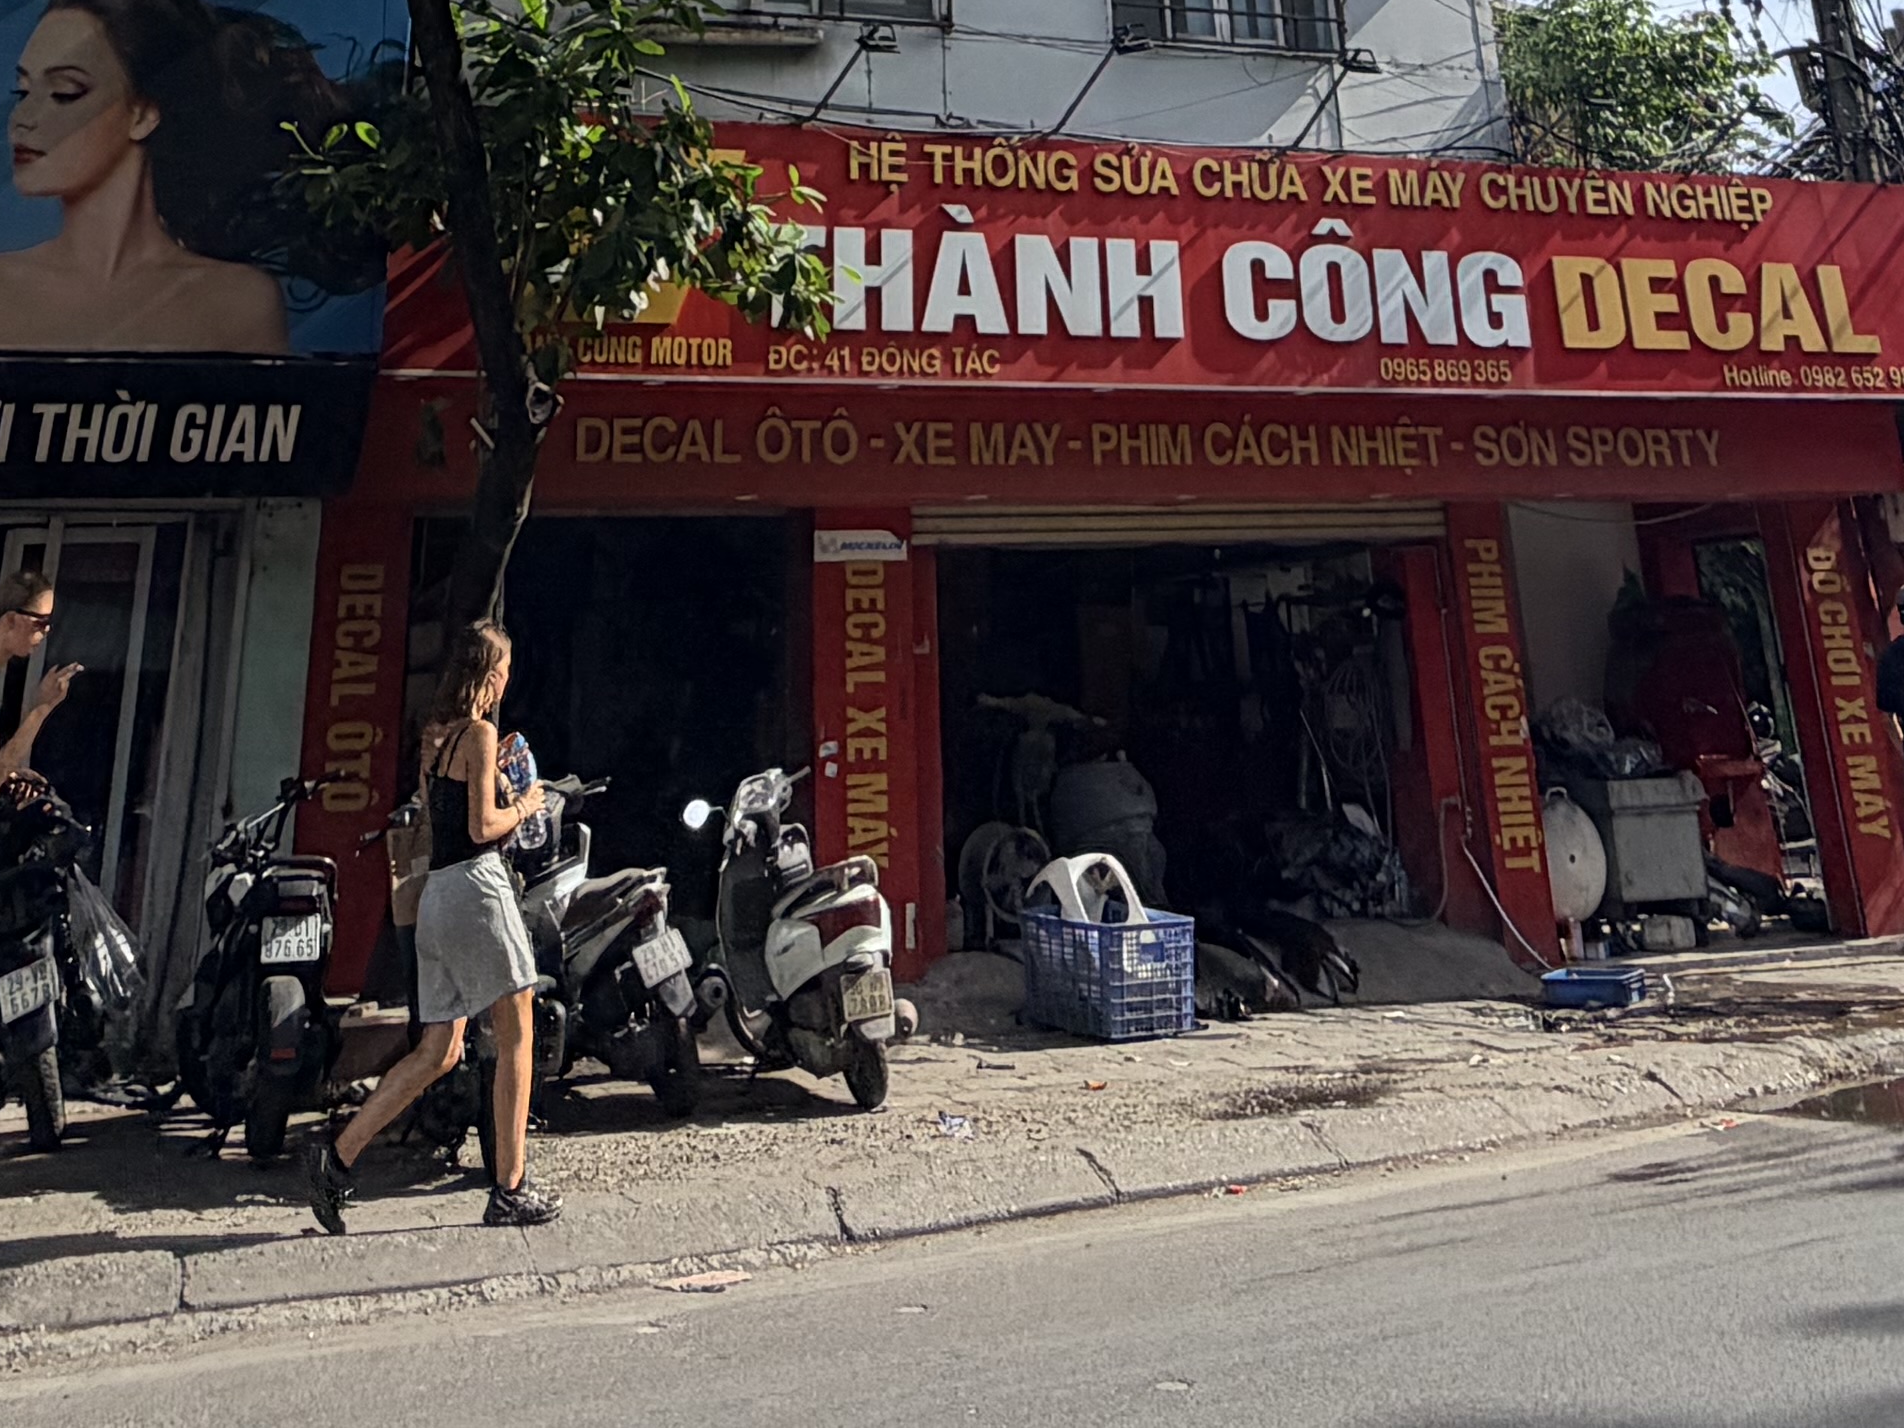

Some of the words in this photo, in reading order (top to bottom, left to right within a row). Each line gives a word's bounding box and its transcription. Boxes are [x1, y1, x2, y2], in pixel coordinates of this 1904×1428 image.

[849, 133, 910, 193] HỆ
[922, 136, 1079, 192] THỐNG
[1093, 142, 1180, 197] SỬA
[1193, 148, 1308, 202] CHỮA
[1320, 164, 1377, 206] XE
[1388, 160, 1466, 209] MÁY
[1480, 172, 1635, 217] CHUYÊN
[1644, 177, 1774, 232] NGHIỆP
[1222, 218, 1532, 348] CÔNG
[1551, 255, 1882, 355] DECAL
[650, 336, 733, 366] MOTOR
[861, 341, 942, 375] ĐÔNG
[951, 343, 1001, 375] TÁC
[1800, 365, 1849, 388] 0982
[1851, 365, 1887, 389] 652
[31, 388, 159, 464] THỜI
[168, 403, 303, 464] GIAN
[575, 415, 742, 464] DECAL
[755, 405, 859, 465] ÔTÔ
[894, 420, 957, 465] XE
[1091, 422, 1194, 466] PHIM
[1203, 413, 1321, 466] CÁCH
[1329, 415, 1444, 475] NHIỆT
[1472, 419, 1559, 467] SƠN
[1565, 424, 1722, 467] SPORTY
[1463, 537, 1511, 634] PHIM
[329, 563, 385, 708] DECAL
[844, 559, 888, 694] DECAL
[845, 705, 889, 764] XE
[1834, 696, 1873, 746] XE
[322, 719, 384, 813] ÔTÔ
[1845, 755, 1893, 840] MÁY
